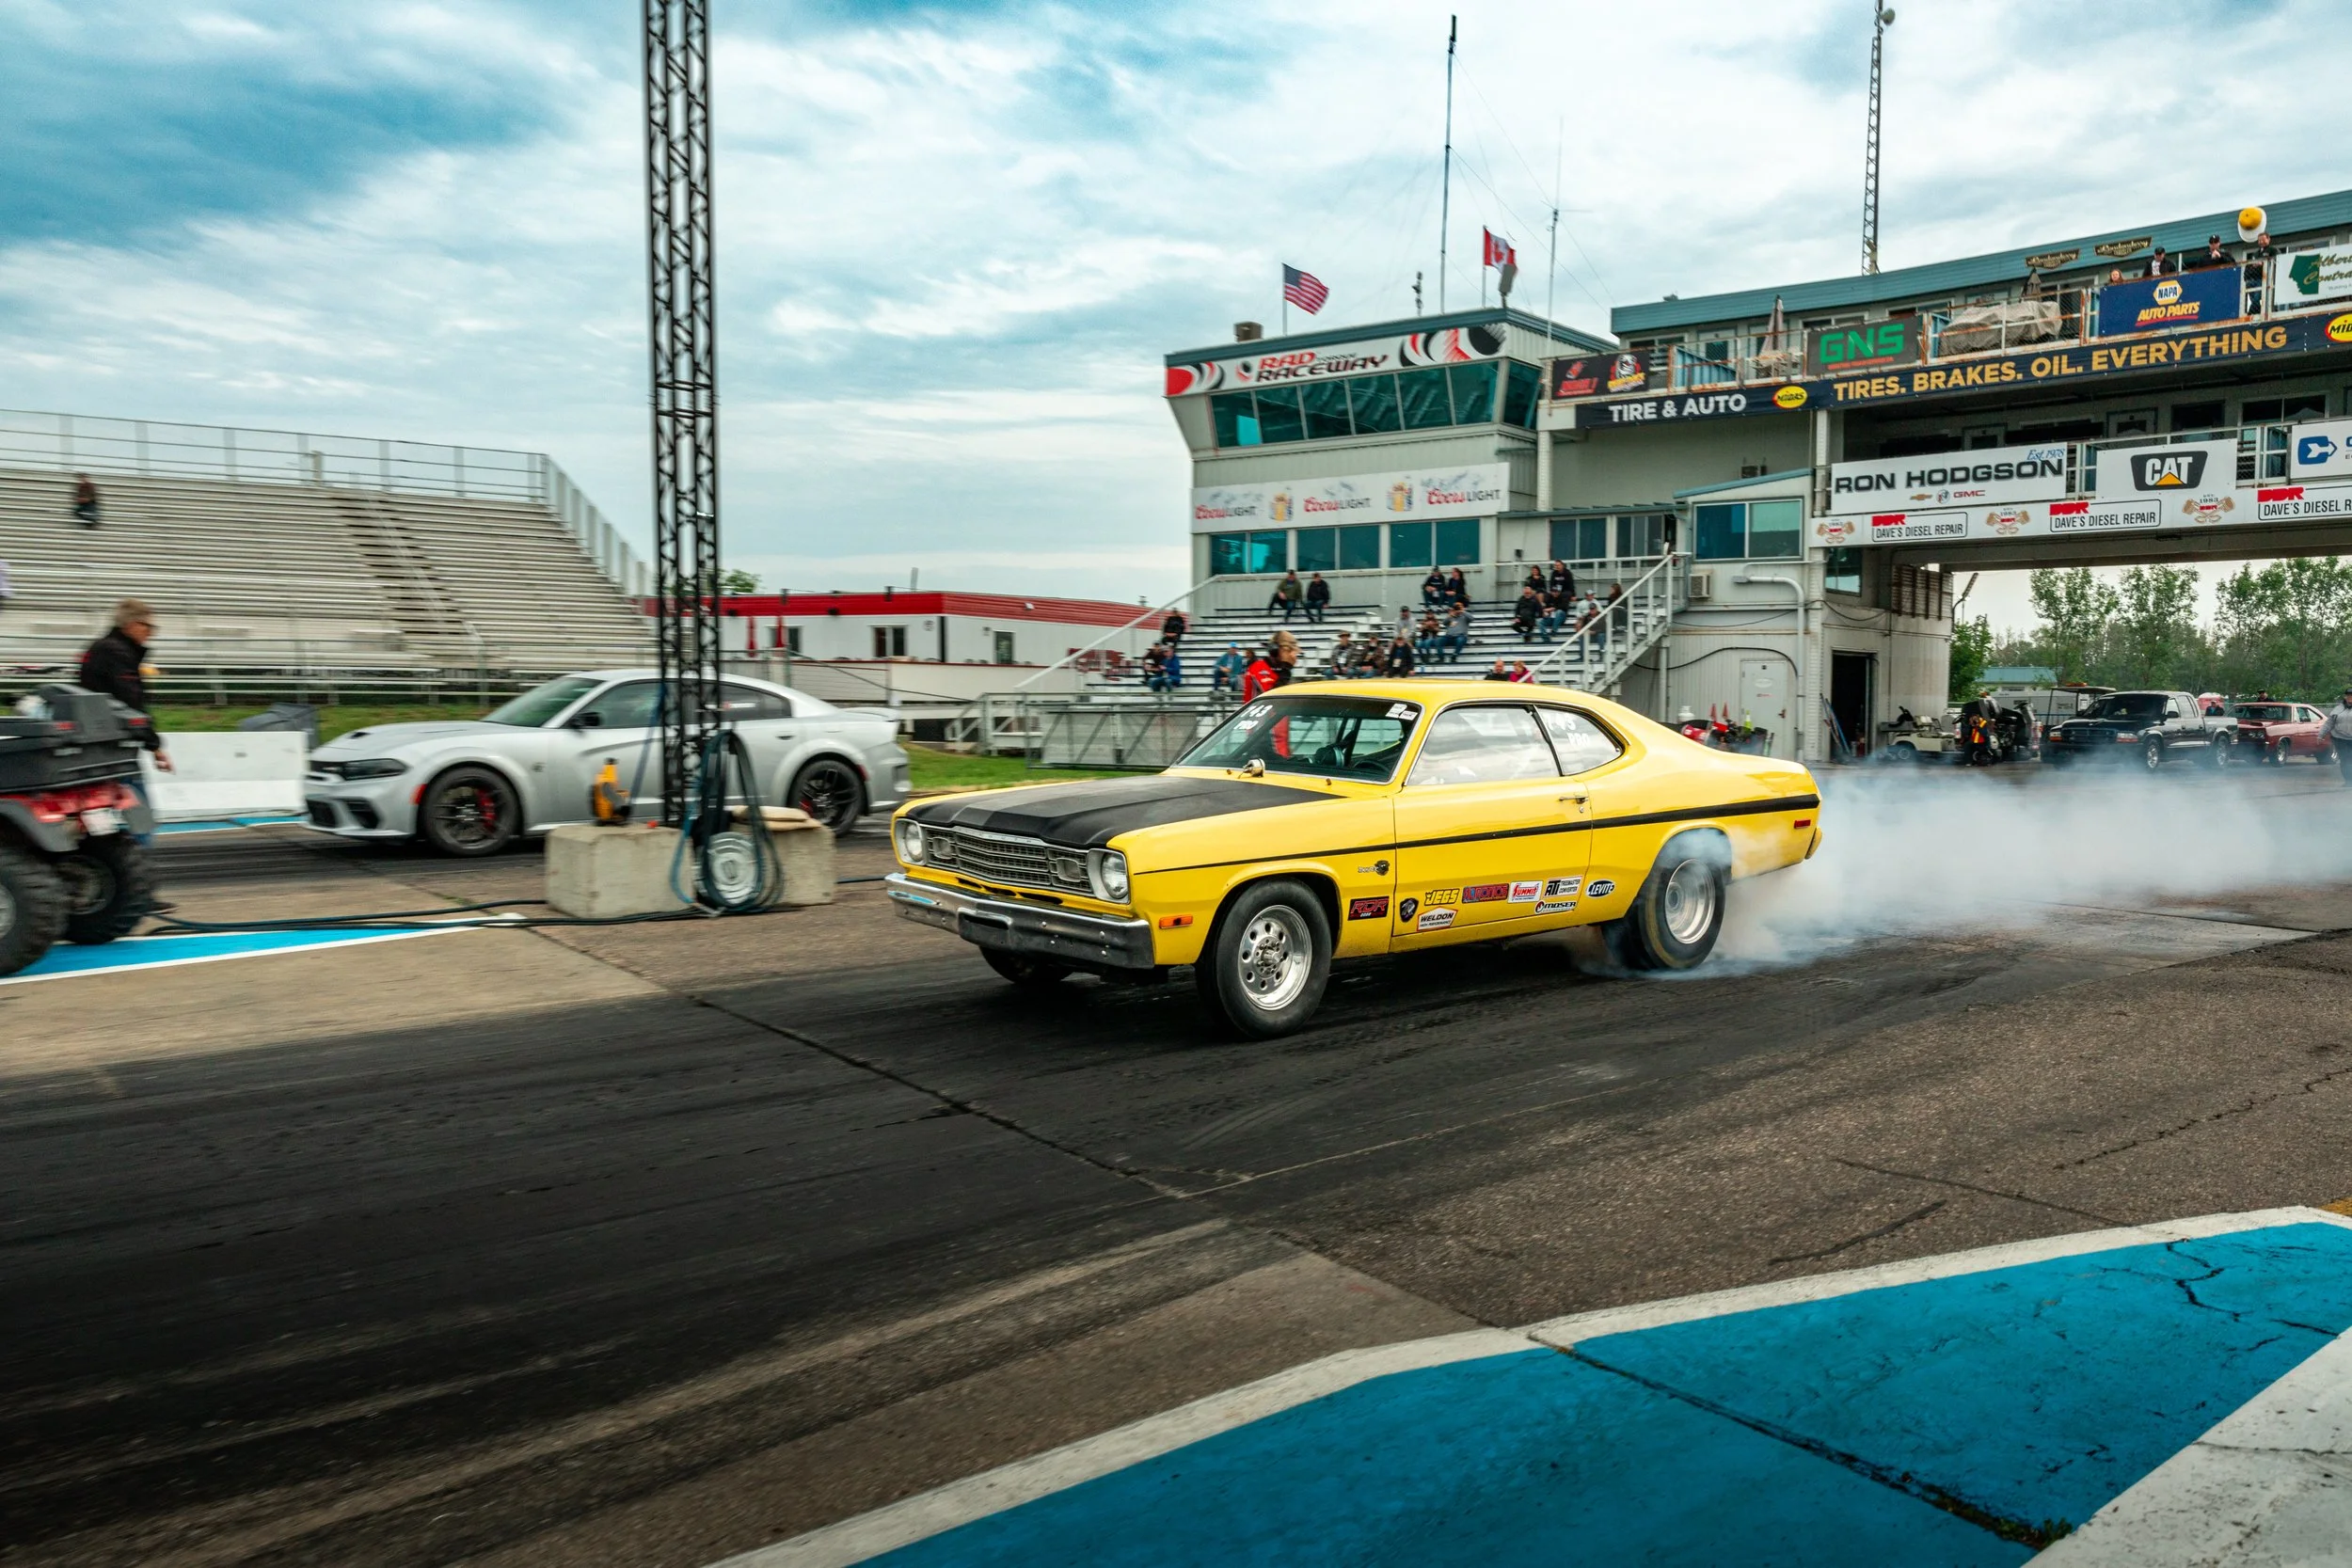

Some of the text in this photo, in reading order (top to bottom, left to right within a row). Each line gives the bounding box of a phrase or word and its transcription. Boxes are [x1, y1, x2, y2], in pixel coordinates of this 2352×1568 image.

[2158, 286, 2178, 299] NAPA
[2137, 301, 2201, 322] AUTO PARTS
[1820, 323, 1905, 364] GNS
[1256, 355, 1390, 382] RACEWAY
[1259, 352, 1317, 370] RAD
[1834, 376, 1906, 402] TIRES.
[1913, 361, 2023, 392] BRAKES.
[2030, 355, 2083, 377] OIL.
[2091, 325, 2287, 372] EVERYTHING
[1608, 393, 1747, 422] TIRE & AUTO
[1835, 458, 2064, 495] RON HODGSON
[2145, 456, 2193, 486] CAT
[1467, 489, 1502, 502] LIGHT
[1953, 489, 1986, 499] GMC
[2258, 486, 2304, 502] DDR
[2049, 501, 2090, 515] DDR
[2264, 502, 2299, 516] DAVE'S
[2304, 499, 2341, 514] DIESEL
[1871, 514, 1906, 527] DDR
[2055, 512, 2156, 529] DAVE'S DIESEL REPAIR
[1876, 523, 1963, 539] DAVE'S DIESEL REPAIR
[1545, 879, 1562, 896] ATI
[1425, 889, 1460, 906] JEGS
[1421, 912, 1454, 922] WELDON
